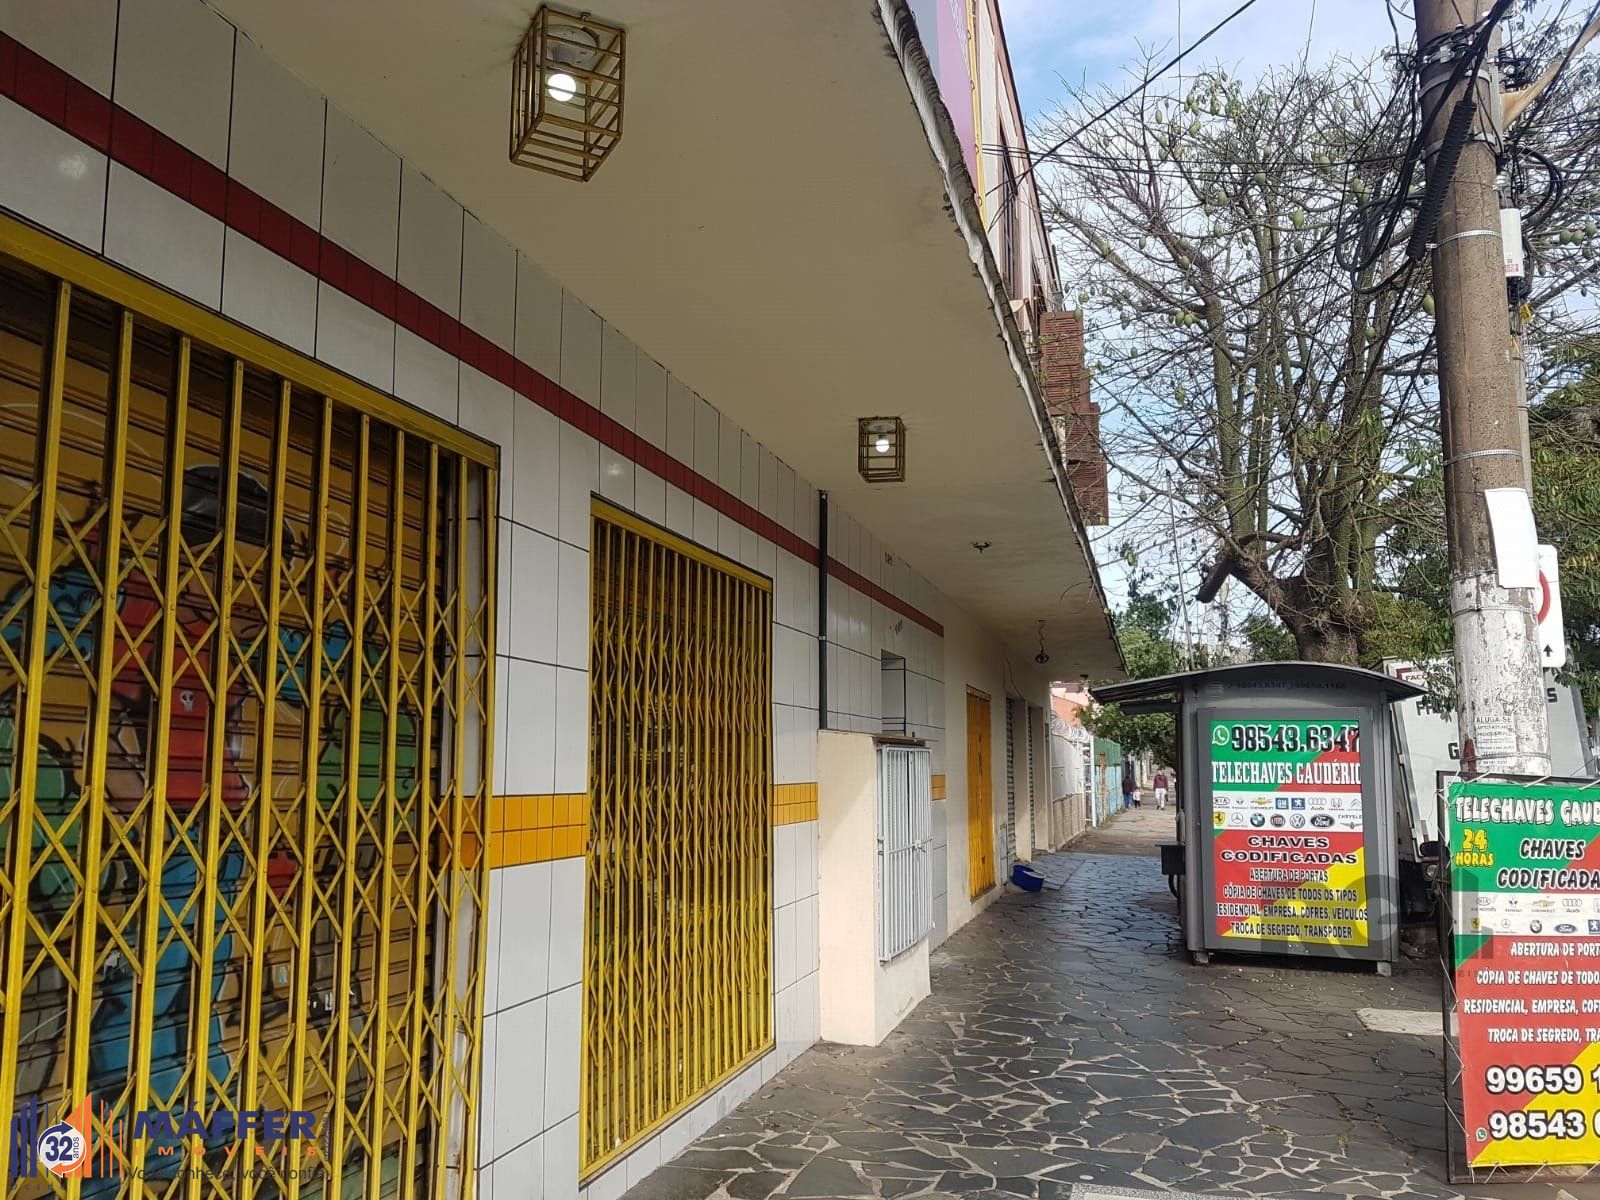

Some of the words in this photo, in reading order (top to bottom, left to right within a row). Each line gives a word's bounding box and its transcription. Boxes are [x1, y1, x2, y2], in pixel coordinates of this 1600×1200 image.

[1231, 725, 1359, 752] 98543.6347
[1212, 761, 1293, 784] TELECHAVES
[1455, 796, 1554, 824] TELECHAVES
[1248, 836, 1329, 848] CHAVES
[1463, 828, 1488, 851] 24
[1520, 839, 1585, 859] CHAVES
[1221, 850, 1358, 864] CODIFICADAS
[1455, 852, 1495, 867] HORAS
[1250, 868, 1287, 882] ABERTURA
[1289, 870, 1299, 882] DE
[1300, 870, 1329, 883] PORTAS
[1496, 867, 1600, 889] CODIFICADA
[1223, 881, 1244, 900] CÓPIA
[1246, 886, 1256, 900] DE
[1258, 887, 1286, 901] CHAVES
[1287, 888, 1297, 901] DE
[1298, 888, 1322, 902] TODOS
[1324, 889, 1334, 902] OS
[1335, 890, 1357, 902] TIPOS
[1230, 922, 1255, 936] TROCA
[1256, 923, 1265, 936] DE
[1304, 926, 1352, 940] TRANSPODER
[1510, 942, 1560, 957] ABERTURA
[1562, 943, 1575, 957] DE
[1476, 966, 1505, 985] CÓPIA
[1507, 970, 1521, 985] DE
[1523, 970, 1558, 985] CHAVES
[1561, 970, 1574, 985] DE
[1463, 999, 1528, 1015] RESIDENCIAL,
[1531, 999, 1579, 1015] EMPRESA,
[1487, 1028, 1518, 1043] TROCA
[1521, 1028, 1534, 1043] DE
[1536, 1028, 1582, 1045] SEGREDO,
[1485, 1065, 1584, 1094] 99659
[1488, 1109, 1587, 1140] 98543
